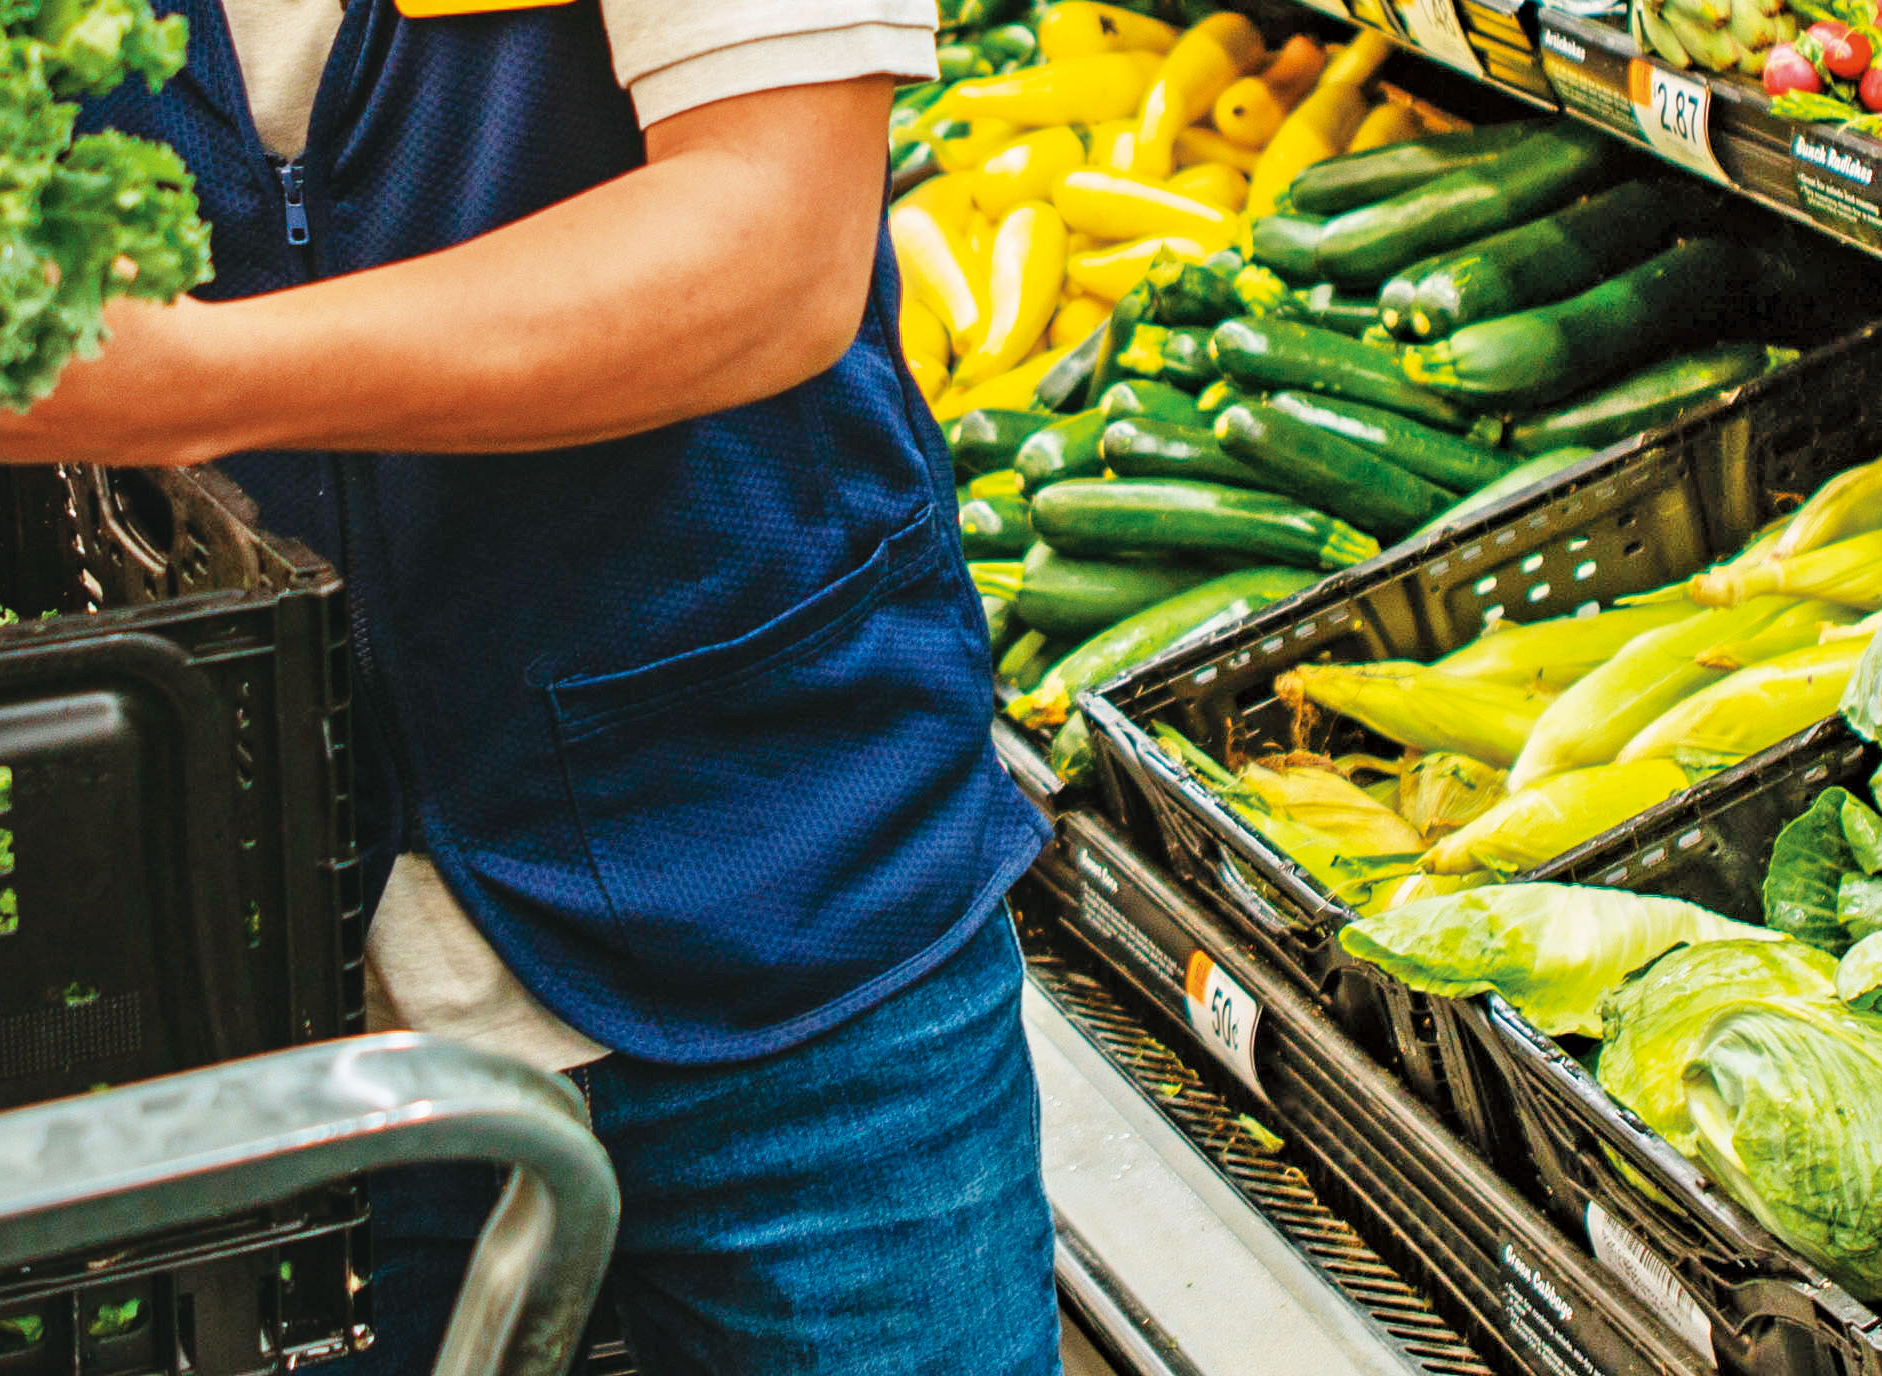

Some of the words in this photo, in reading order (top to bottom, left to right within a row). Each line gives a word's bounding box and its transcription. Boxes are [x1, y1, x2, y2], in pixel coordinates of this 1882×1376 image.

[1792, 133, 1827, 165] Bunch
[1827, 144, 1873, 186] Radishes
[1211, 986, 1240, 1051] 50¢
[1502, 1243, 1532, 1284] Green
[1533, 1270, 1574, 1321] Cabbage
